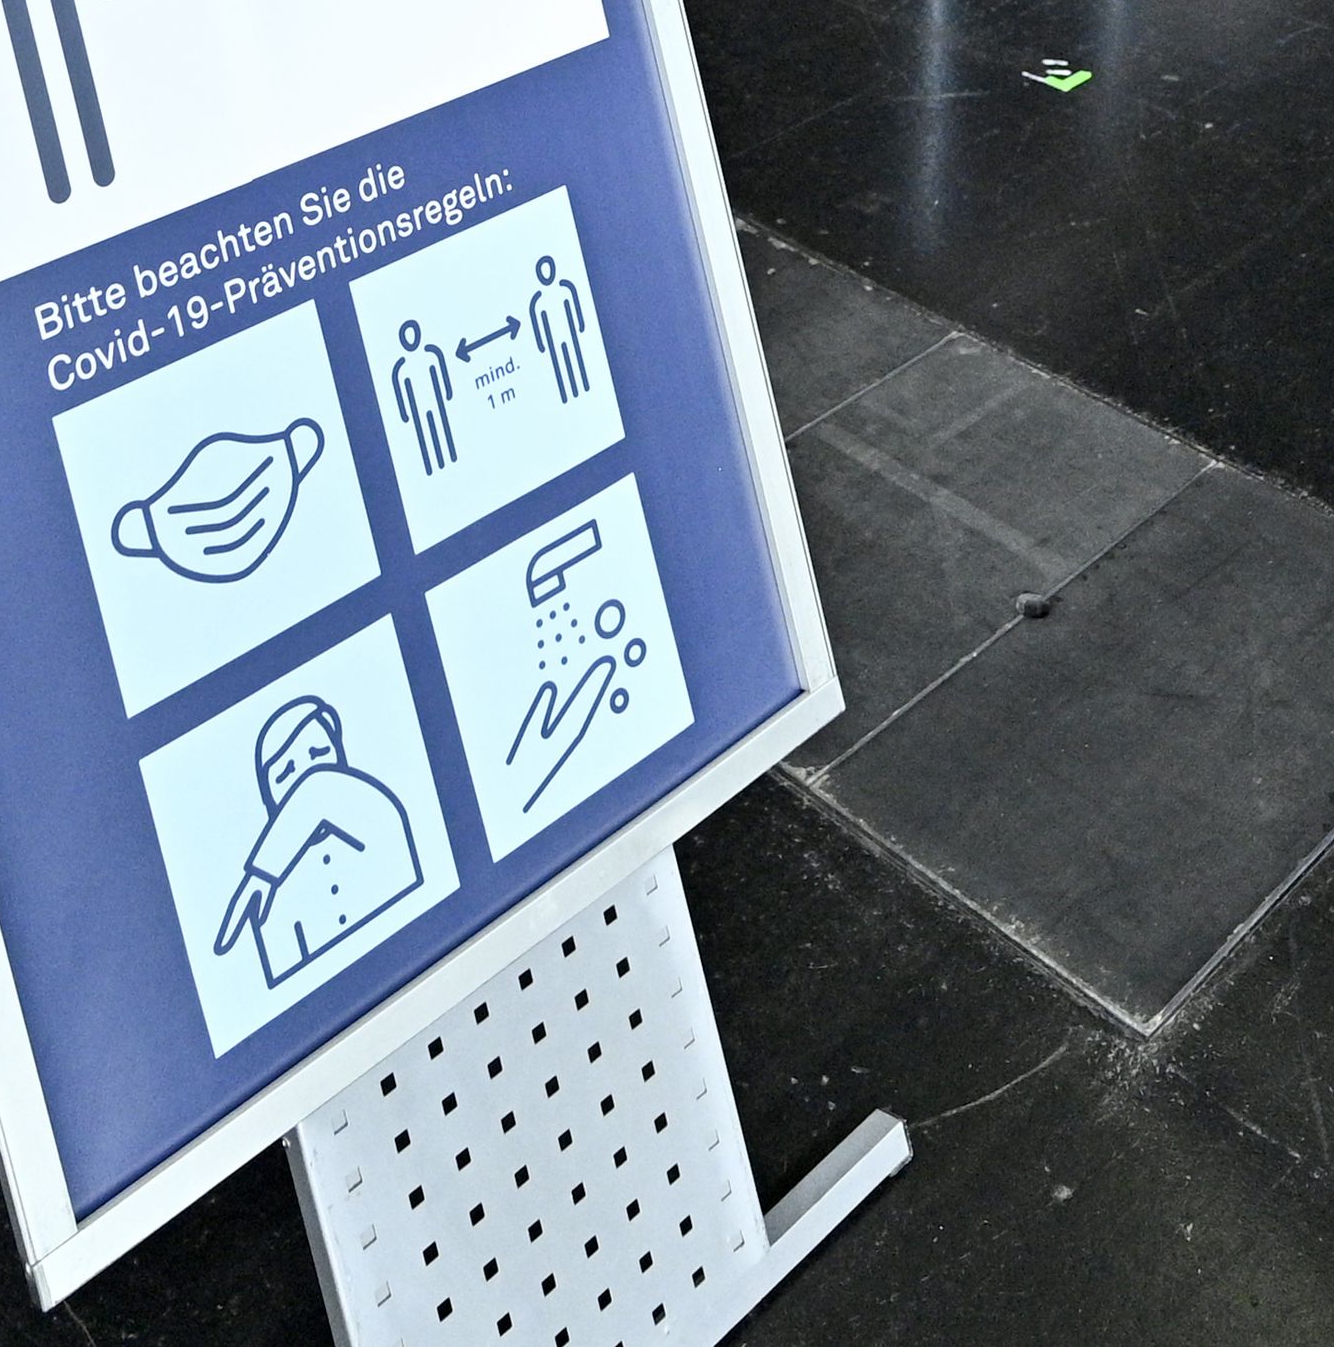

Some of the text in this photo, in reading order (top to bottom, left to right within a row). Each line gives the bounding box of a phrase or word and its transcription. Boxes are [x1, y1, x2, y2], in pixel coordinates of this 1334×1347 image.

[34, 163, 405, 341] Bitte beachten Sie die
[47, 168, 513, 391] Covid-19-Präventionsregeln:
[474, 356, 521, 390] mind.
[487, 387, 516, 409] 1 m
